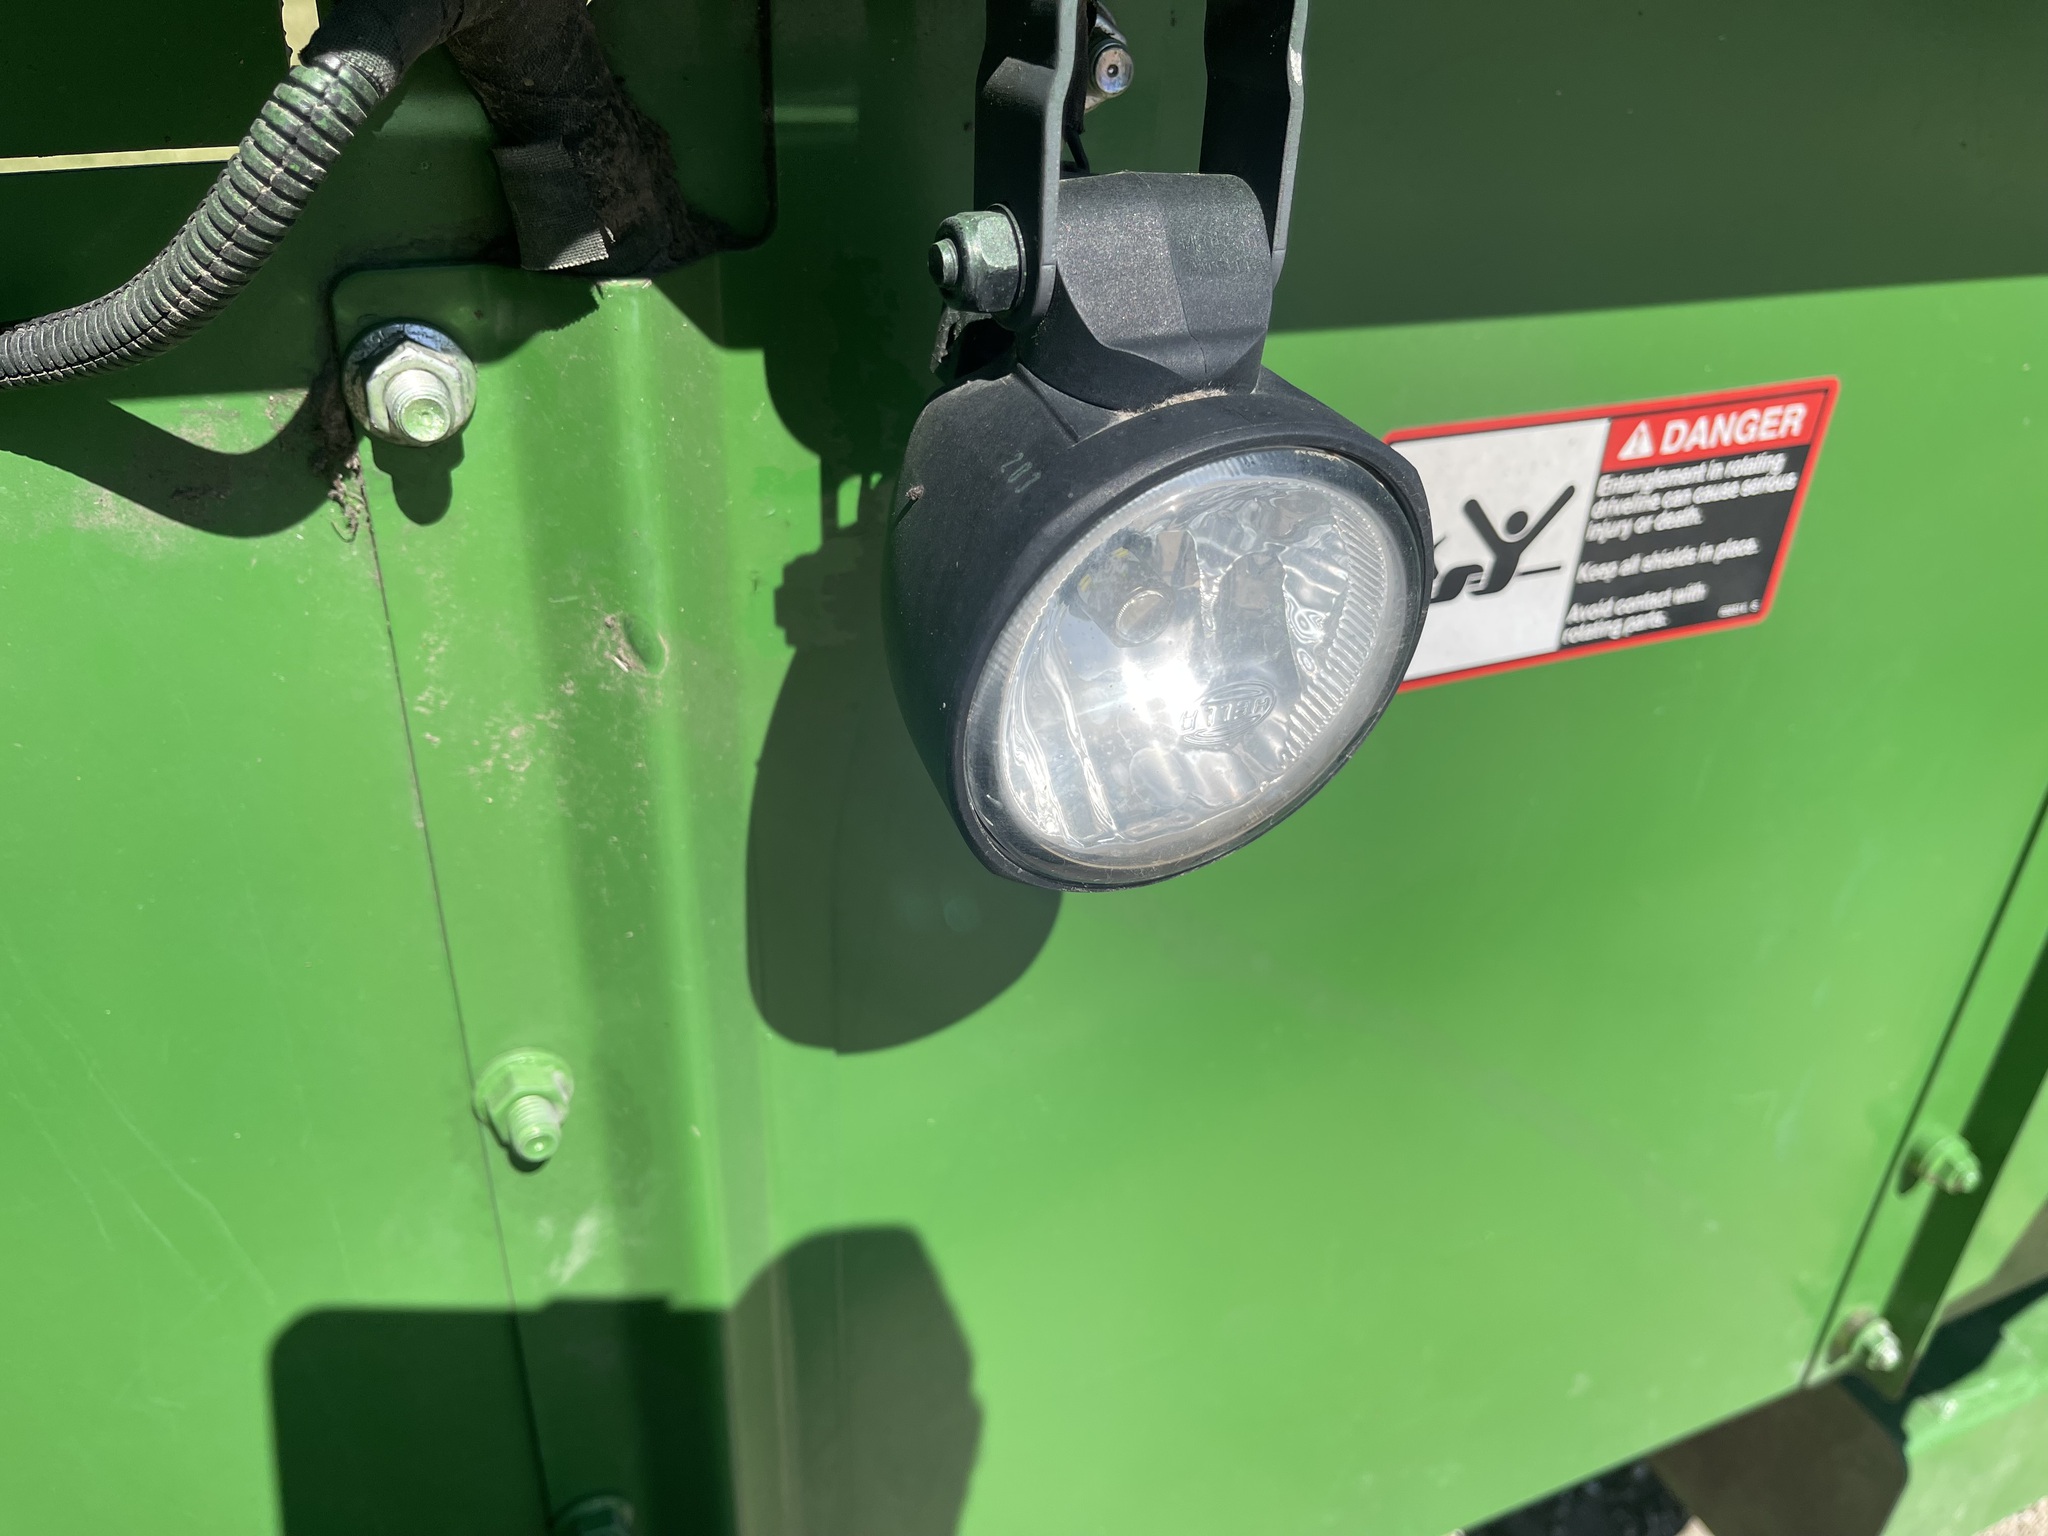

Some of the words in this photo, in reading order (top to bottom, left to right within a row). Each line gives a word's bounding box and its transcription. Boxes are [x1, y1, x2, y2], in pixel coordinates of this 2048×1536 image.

[1659, 402, 1807, 455] DANGER
[1596, 461, 1706, 496] Entanglement
[1706, 459, 1725, 481] in
[1724, 451, 1788, 478] rotating
[1661, 488, 1693, 509] can
[1692, 480, 1741, 504] cause
[1740, 472, 1798, 497] serious
[1585, 518, 1634, 544] injury
[1633, 514, 1655, 534] or
[1575, 560, 1620, 584] Keep
[1619, 552, 1642, 577] all
[1641, 545, 1697, 573] shields
[1697, 542, 1715, 564] in
[1565, 596, 1616, 625] Avoid
[1613, 587, 1673, 616] contact
[1672, 580, 1709, 605] with
[1561, 618, 1623, 645] rotating
